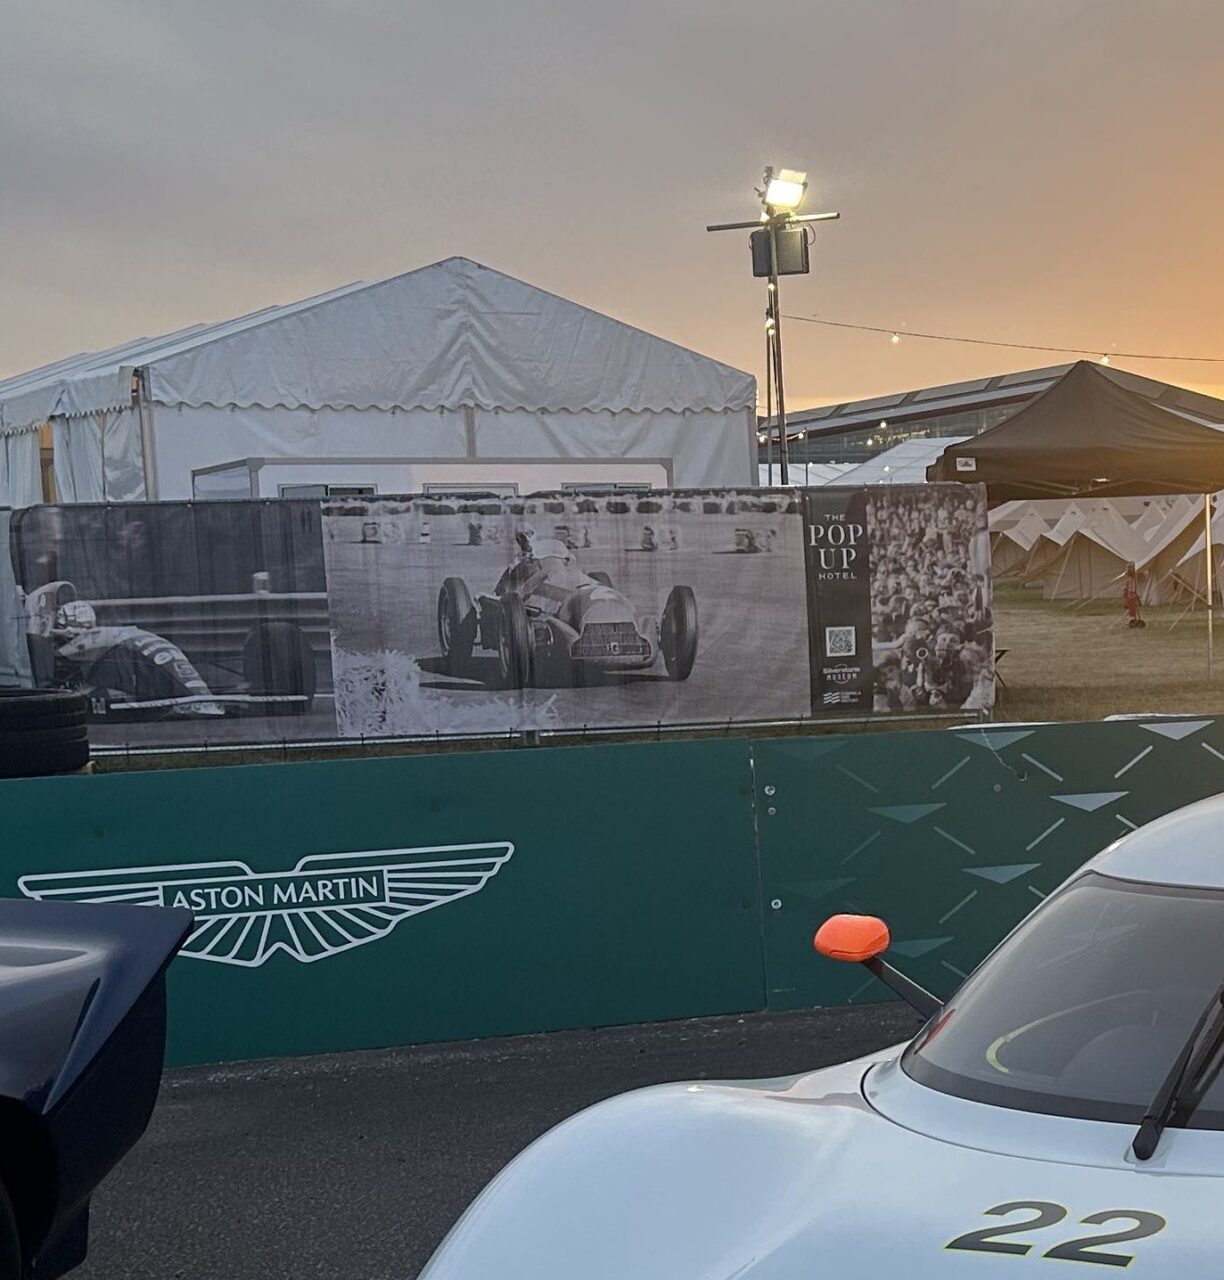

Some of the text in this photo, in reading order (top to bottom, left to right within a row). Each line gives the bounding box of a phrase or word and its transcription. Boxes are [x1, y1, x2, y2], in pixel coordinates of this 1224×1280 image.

[824, 513, 846, 521] THE
[808, 523, 864, 546] POP
[818, 547, 857, 570] UP
[818, 571, 857, 581] HOTEL
[173, 876, 379, 911] ASTON MARTIN
[943, 1199, 1167, 1269] 22
